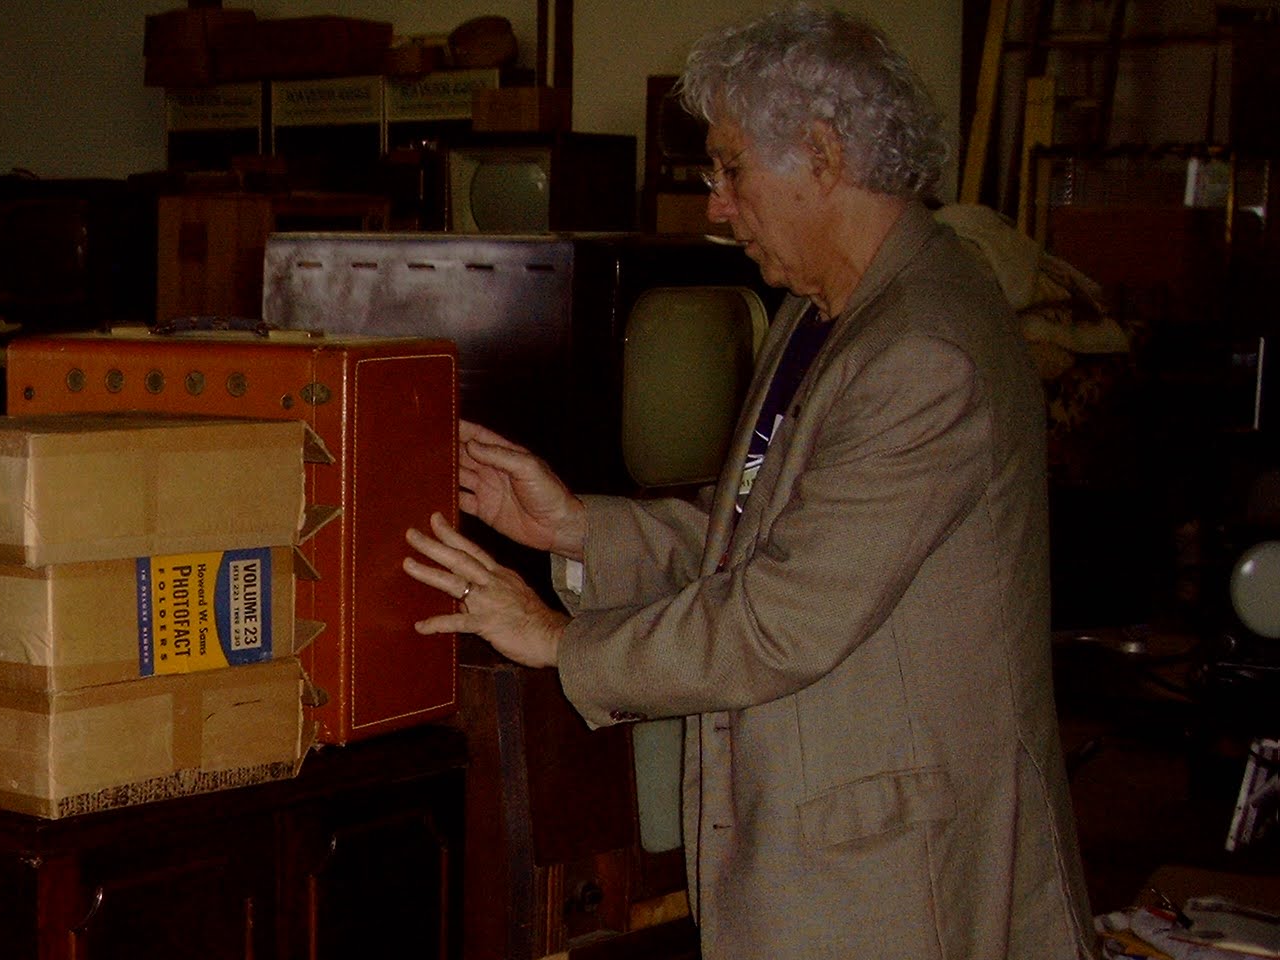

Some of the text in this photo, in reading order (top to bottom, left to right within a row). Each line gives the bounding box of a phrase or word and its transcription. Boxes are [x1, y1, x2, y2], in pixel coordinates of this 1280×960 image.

[158, 568, 168, 661] FOLDERS
[172, 565, 192, 657] PHOTOFACT
[197, 563, 209, 656] Howard W. Sams
[243, 563, 258, 646] VOLUME 23
